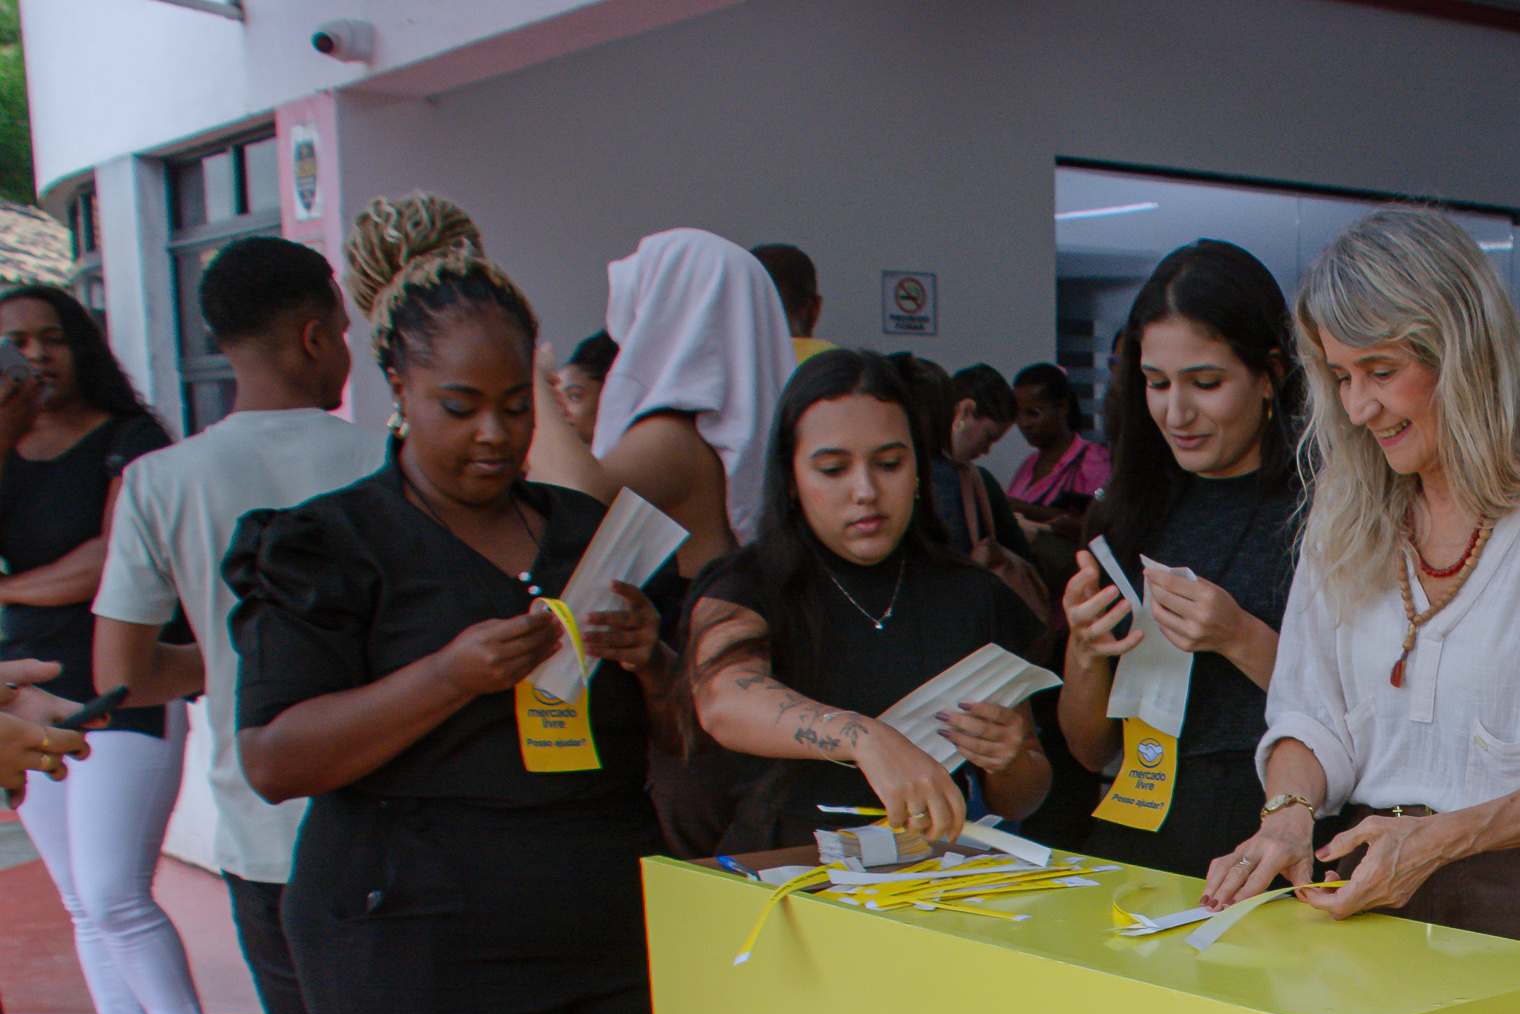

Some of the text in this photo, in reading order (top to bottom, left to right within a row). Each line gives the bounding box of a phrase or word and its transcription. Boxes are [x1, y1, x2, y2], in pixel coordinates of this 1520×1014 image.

[527, 707, 578, 718] mercado
[541, 718, 567, 729] livre
[526, 738, 586, 749] Posso ajudar?
[1128, 769, 1166, 782] mercado
[1135, 780, 1155, 791] livre
[1111, 793, 1165, 810] Posso ajudar?
